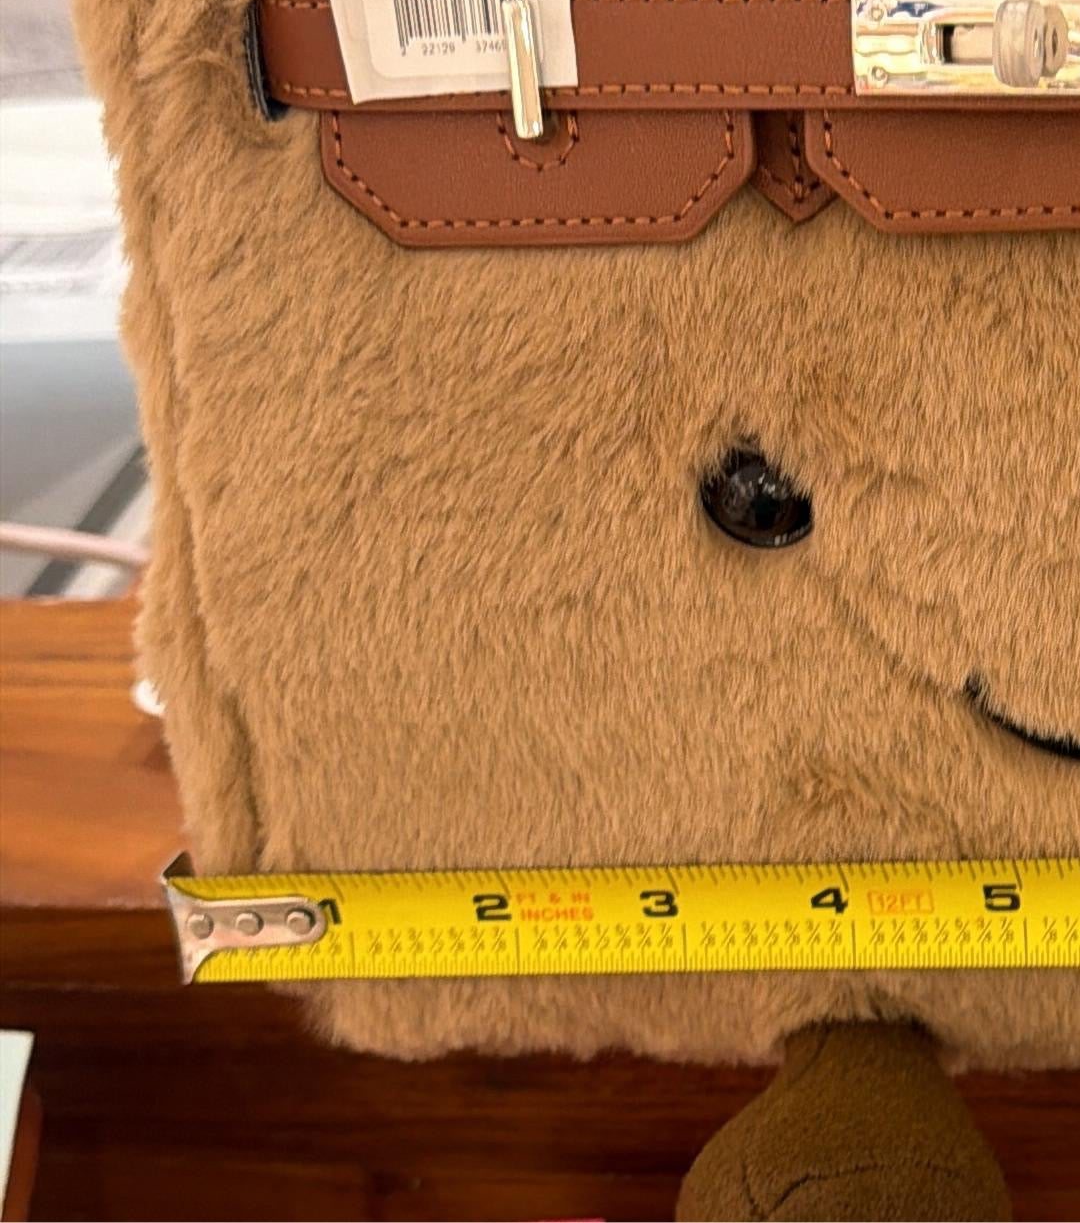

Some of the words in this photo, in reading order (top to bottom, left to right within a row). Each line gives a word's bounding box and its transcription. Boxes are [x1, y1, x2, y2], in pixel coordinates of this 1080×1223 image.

[472, 893, 512, 921] 2
[640, 889, 679, 918] 3
[810, 886, 849, 914] 4
[983, 883, 1021, 912] 5
[520, 907, 594, 922] INCHES
